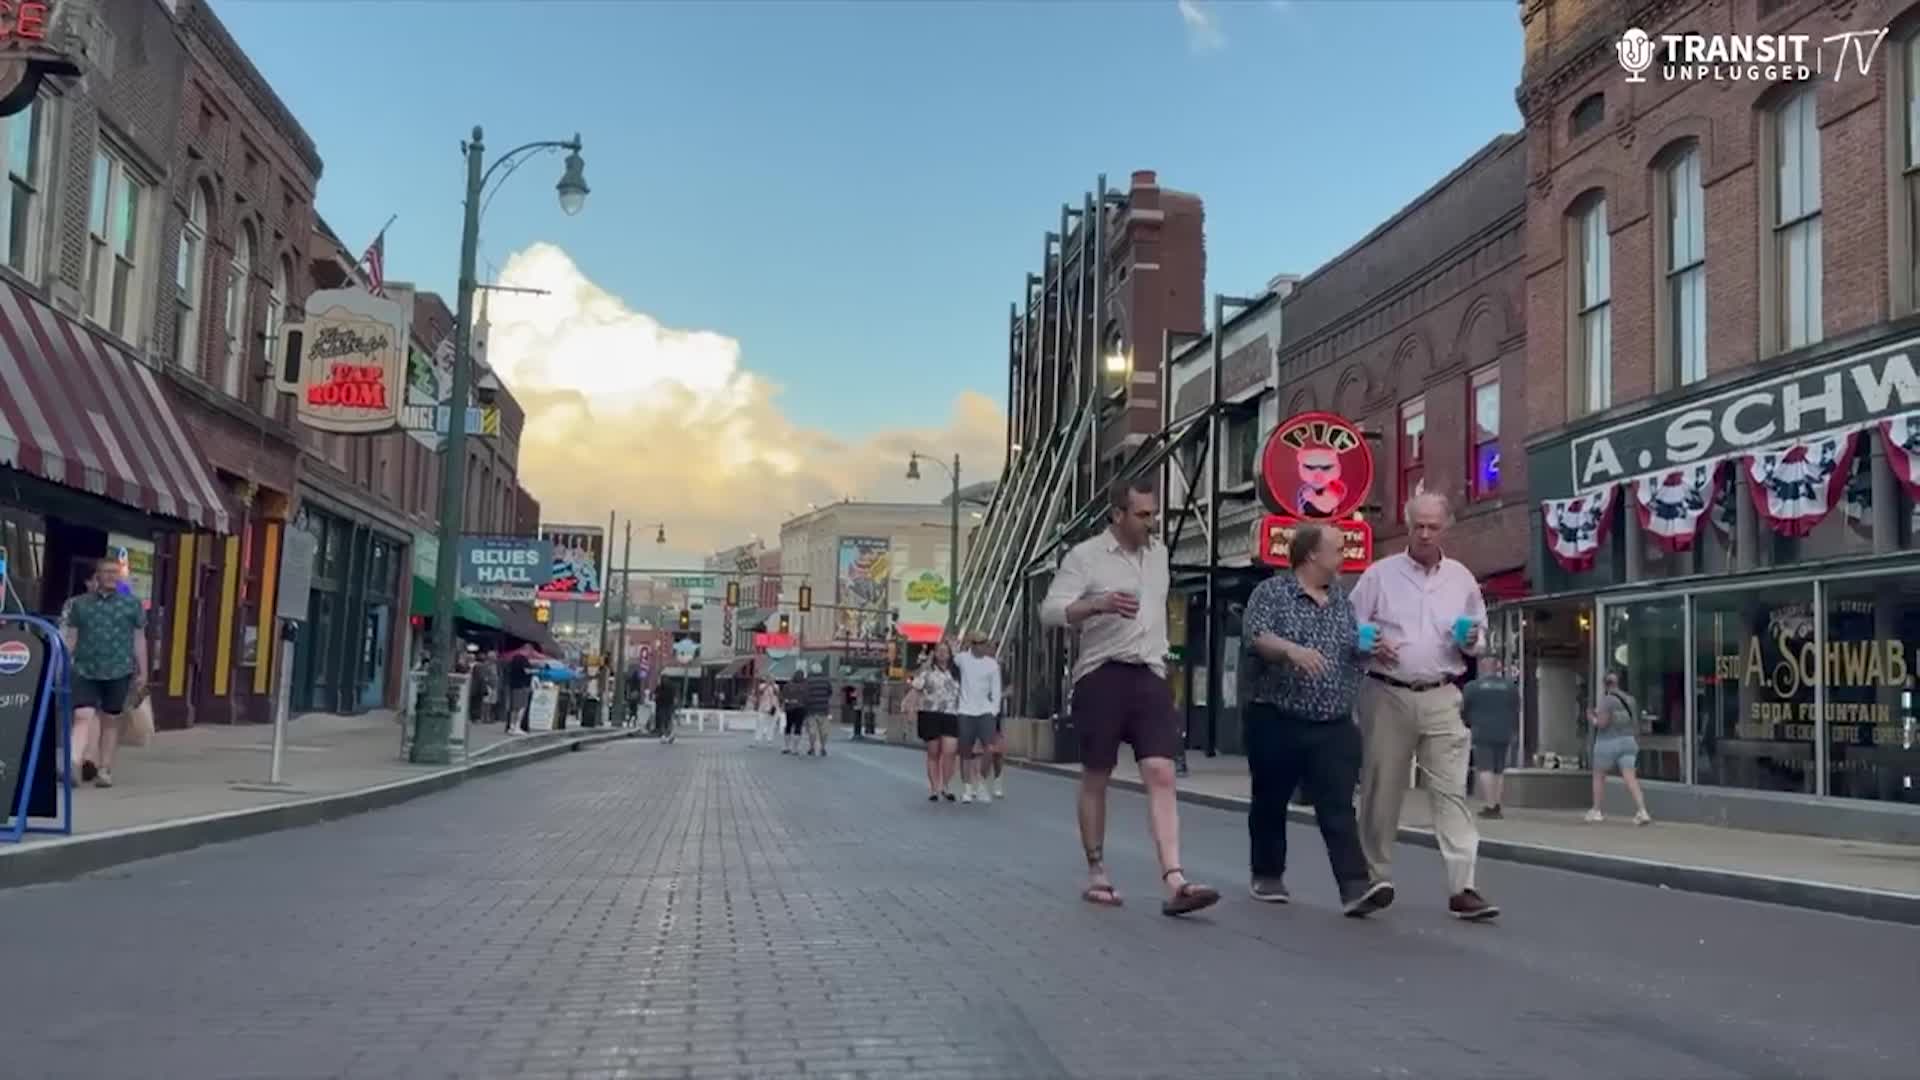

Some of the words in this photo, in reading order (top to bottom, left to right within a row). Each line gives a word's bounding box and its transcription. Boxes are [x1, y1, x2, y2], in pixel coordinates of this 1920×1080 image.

[331, 363, 384, 382] TAP
[1280, 421, 1360, 454] PIG
[471, 549, 540, 565] BLUES
[477, 566, 531, 582] HALL
[1752, 702, 1793, 722] SODA
